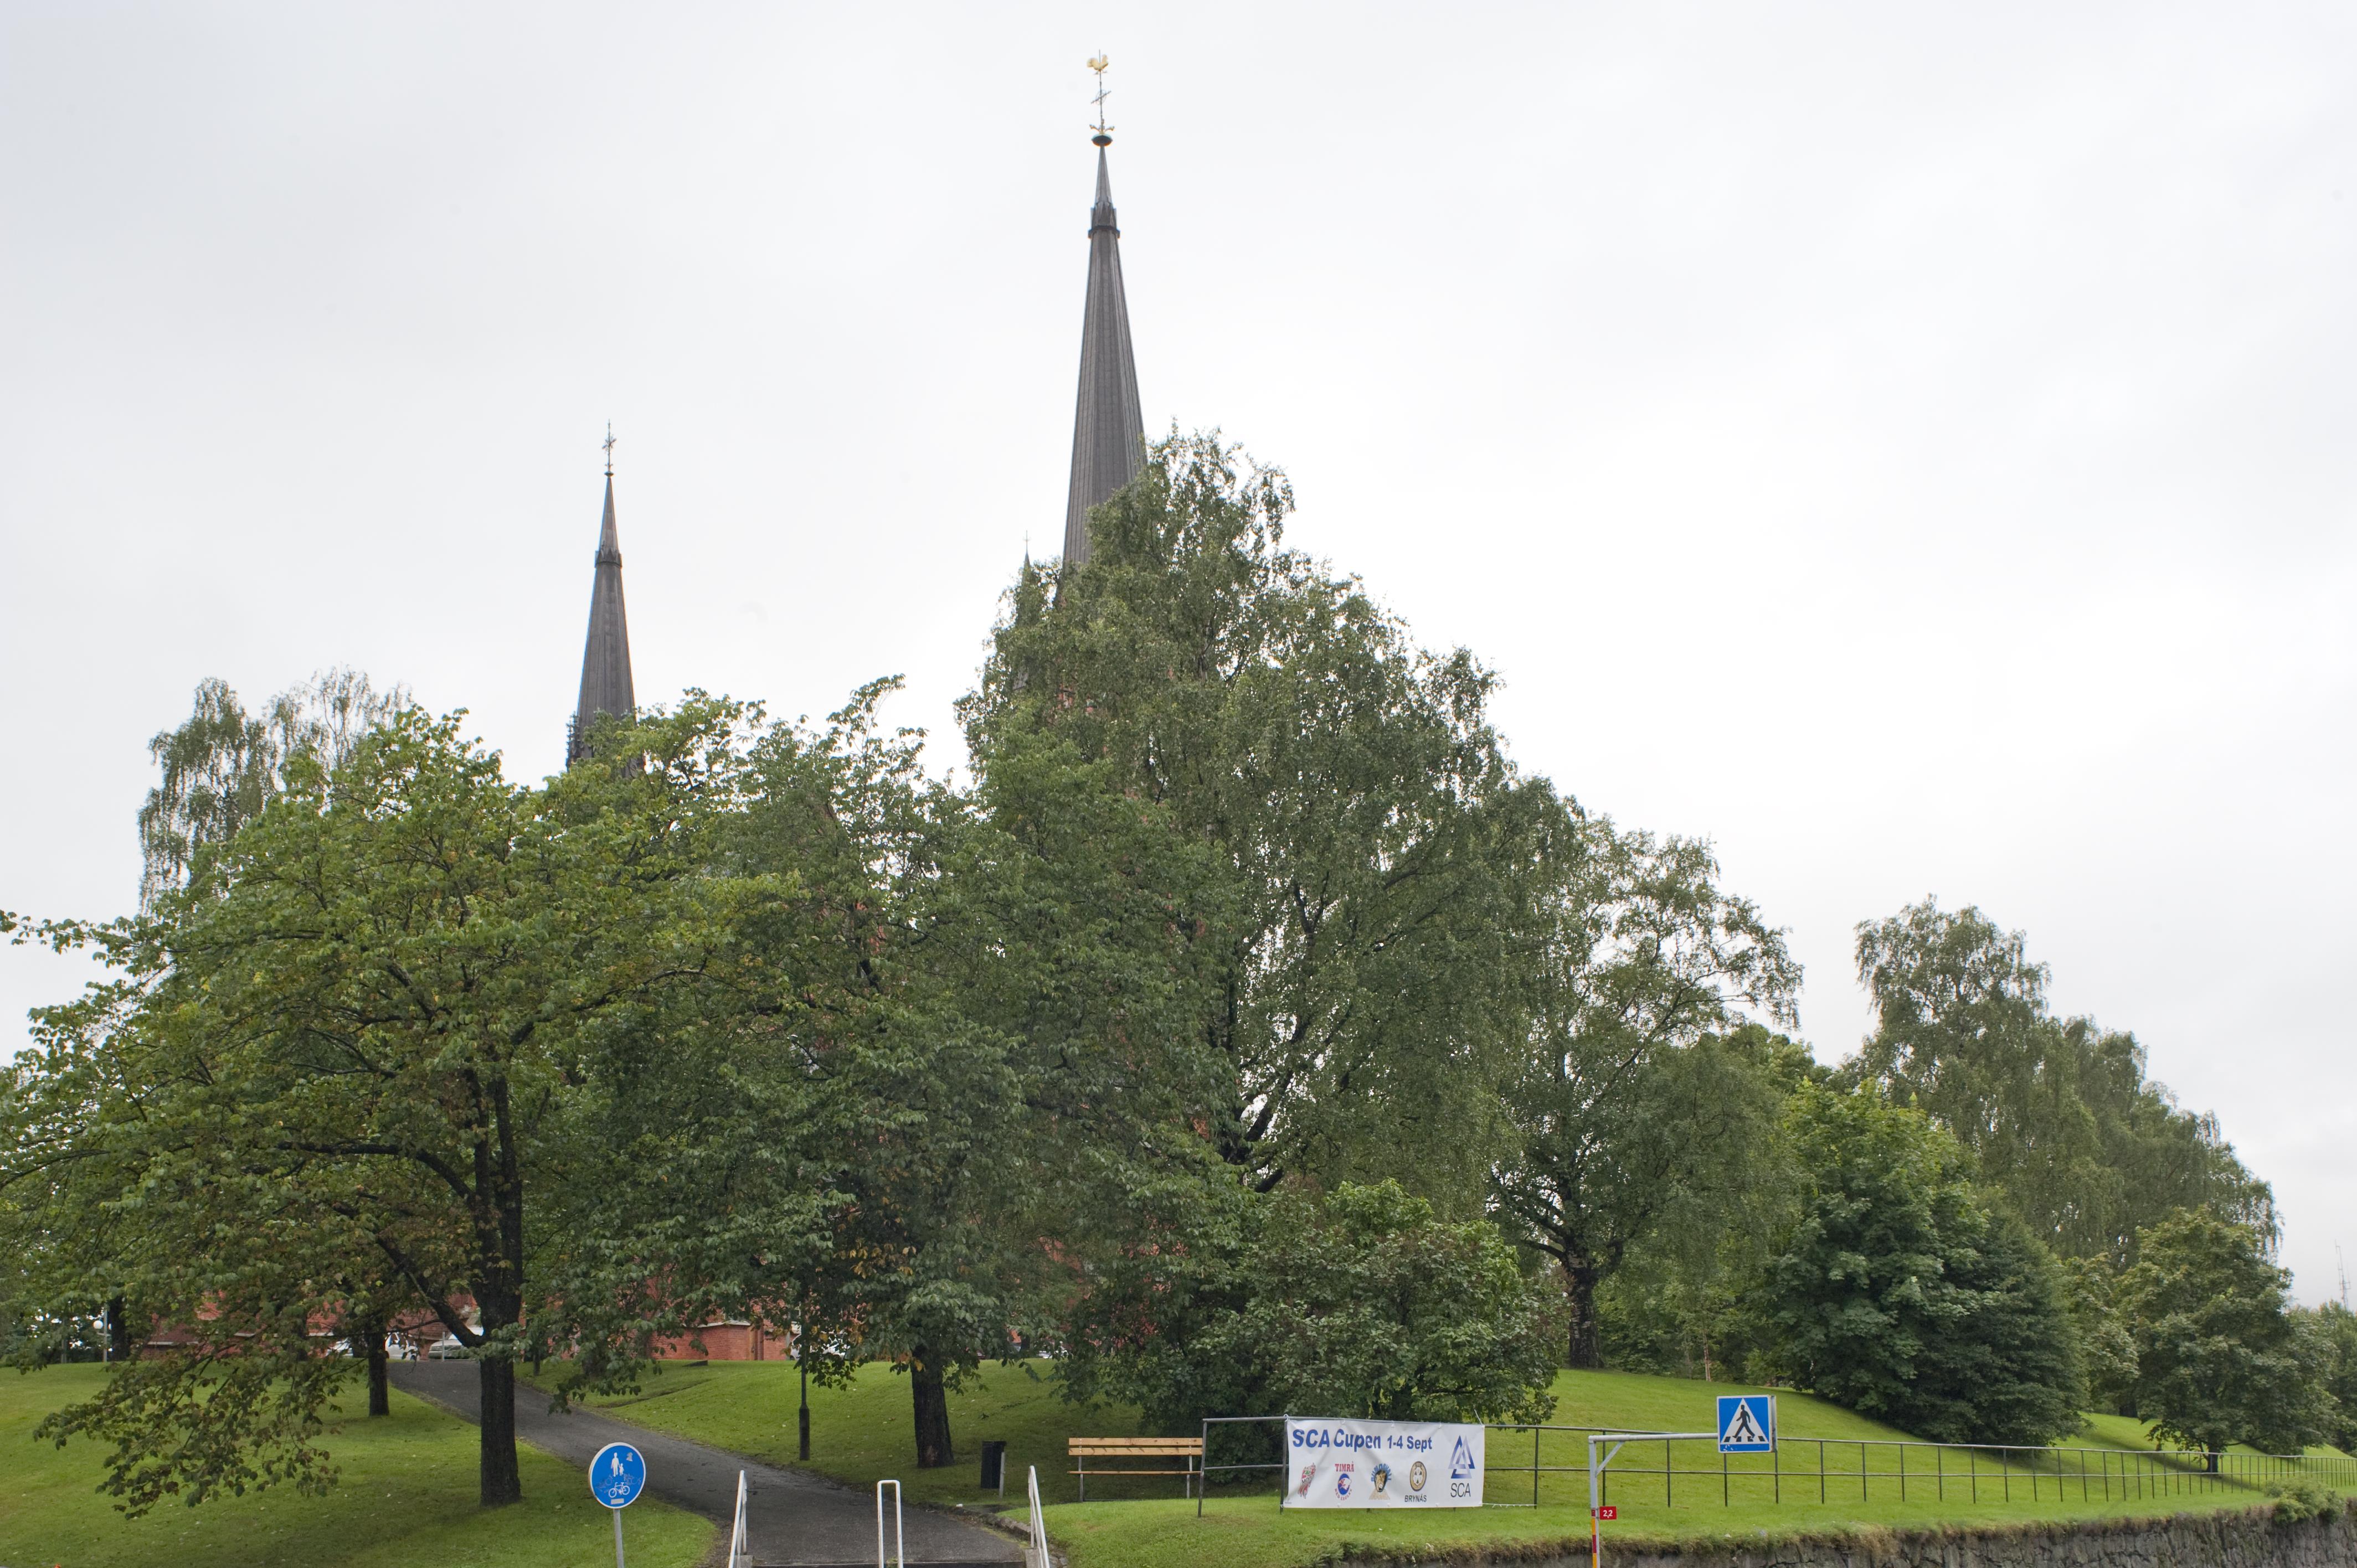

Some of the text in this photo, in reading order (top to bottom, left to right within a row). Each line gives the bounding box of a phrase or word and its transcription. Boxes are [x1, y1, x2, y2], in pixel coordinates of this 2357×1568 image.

[1293, 1428, 1432, 1453] SCA Cupen 1-4 Sept
[1335, 1461, 1354, 1472] TIMRÅ
[1450, 1483, 1471, 1497] SCA
